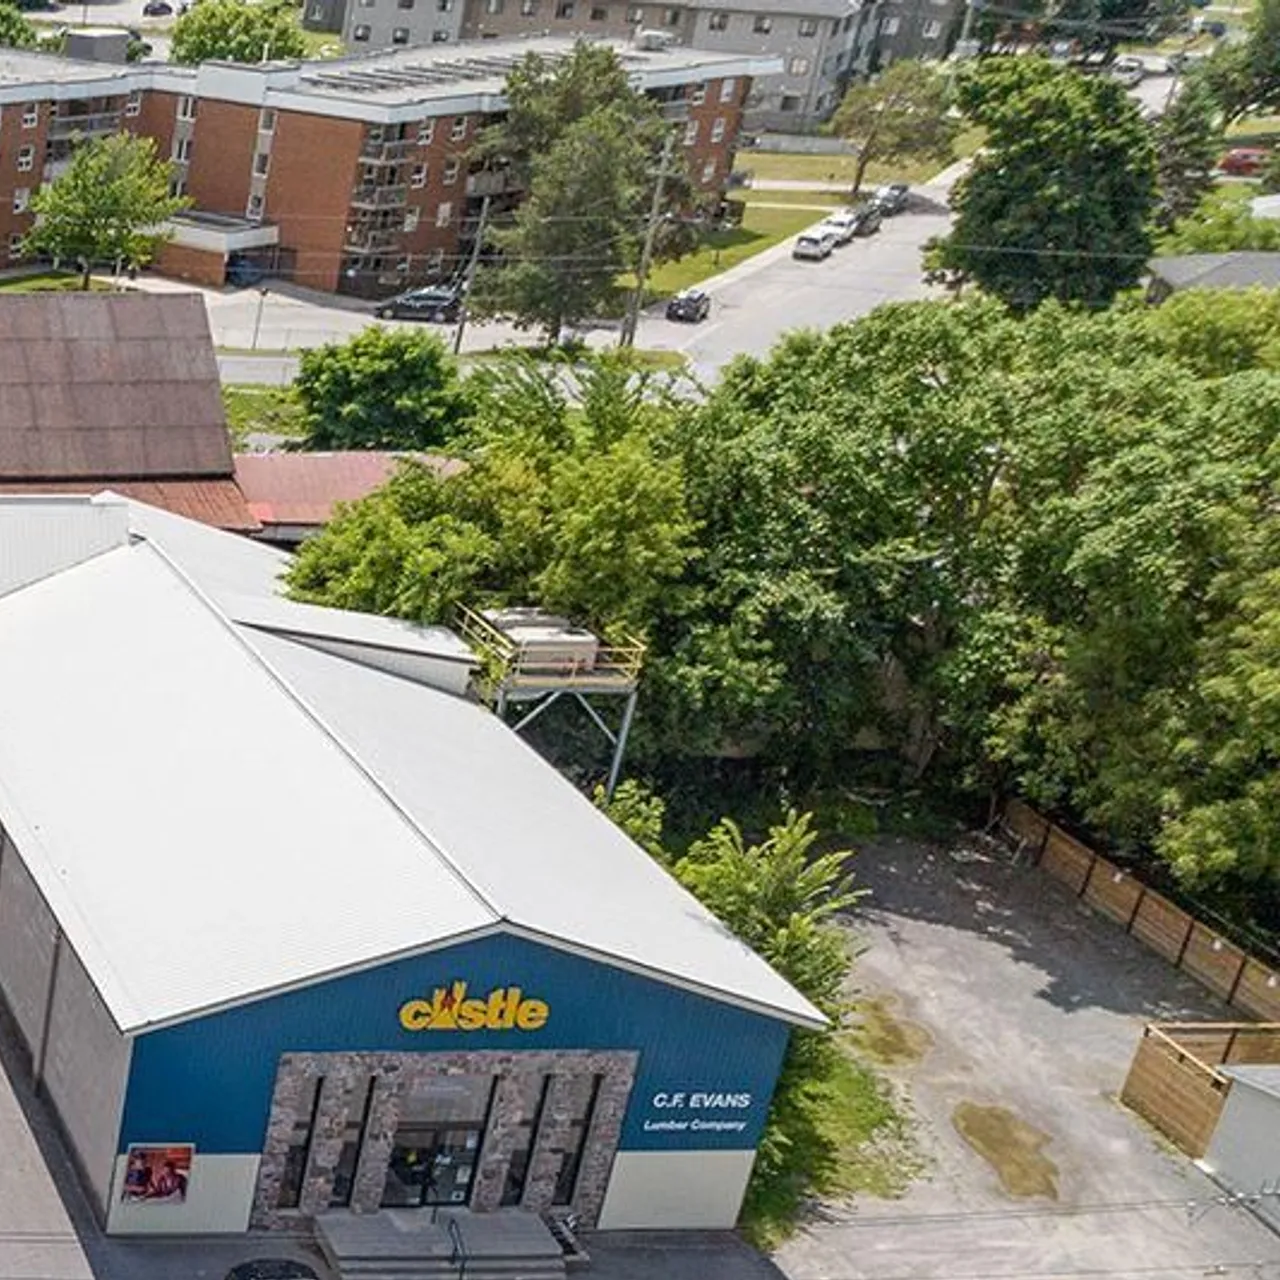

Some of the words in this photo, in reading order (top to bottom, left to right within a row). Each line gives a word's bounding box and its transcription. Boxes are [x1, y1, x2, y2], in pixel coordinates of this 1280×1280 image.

[653, 1092, 687, 1108] C.F.
[689, 1092, 752, 1108] EVANS
[689, 1118, 747, 1132] Company
